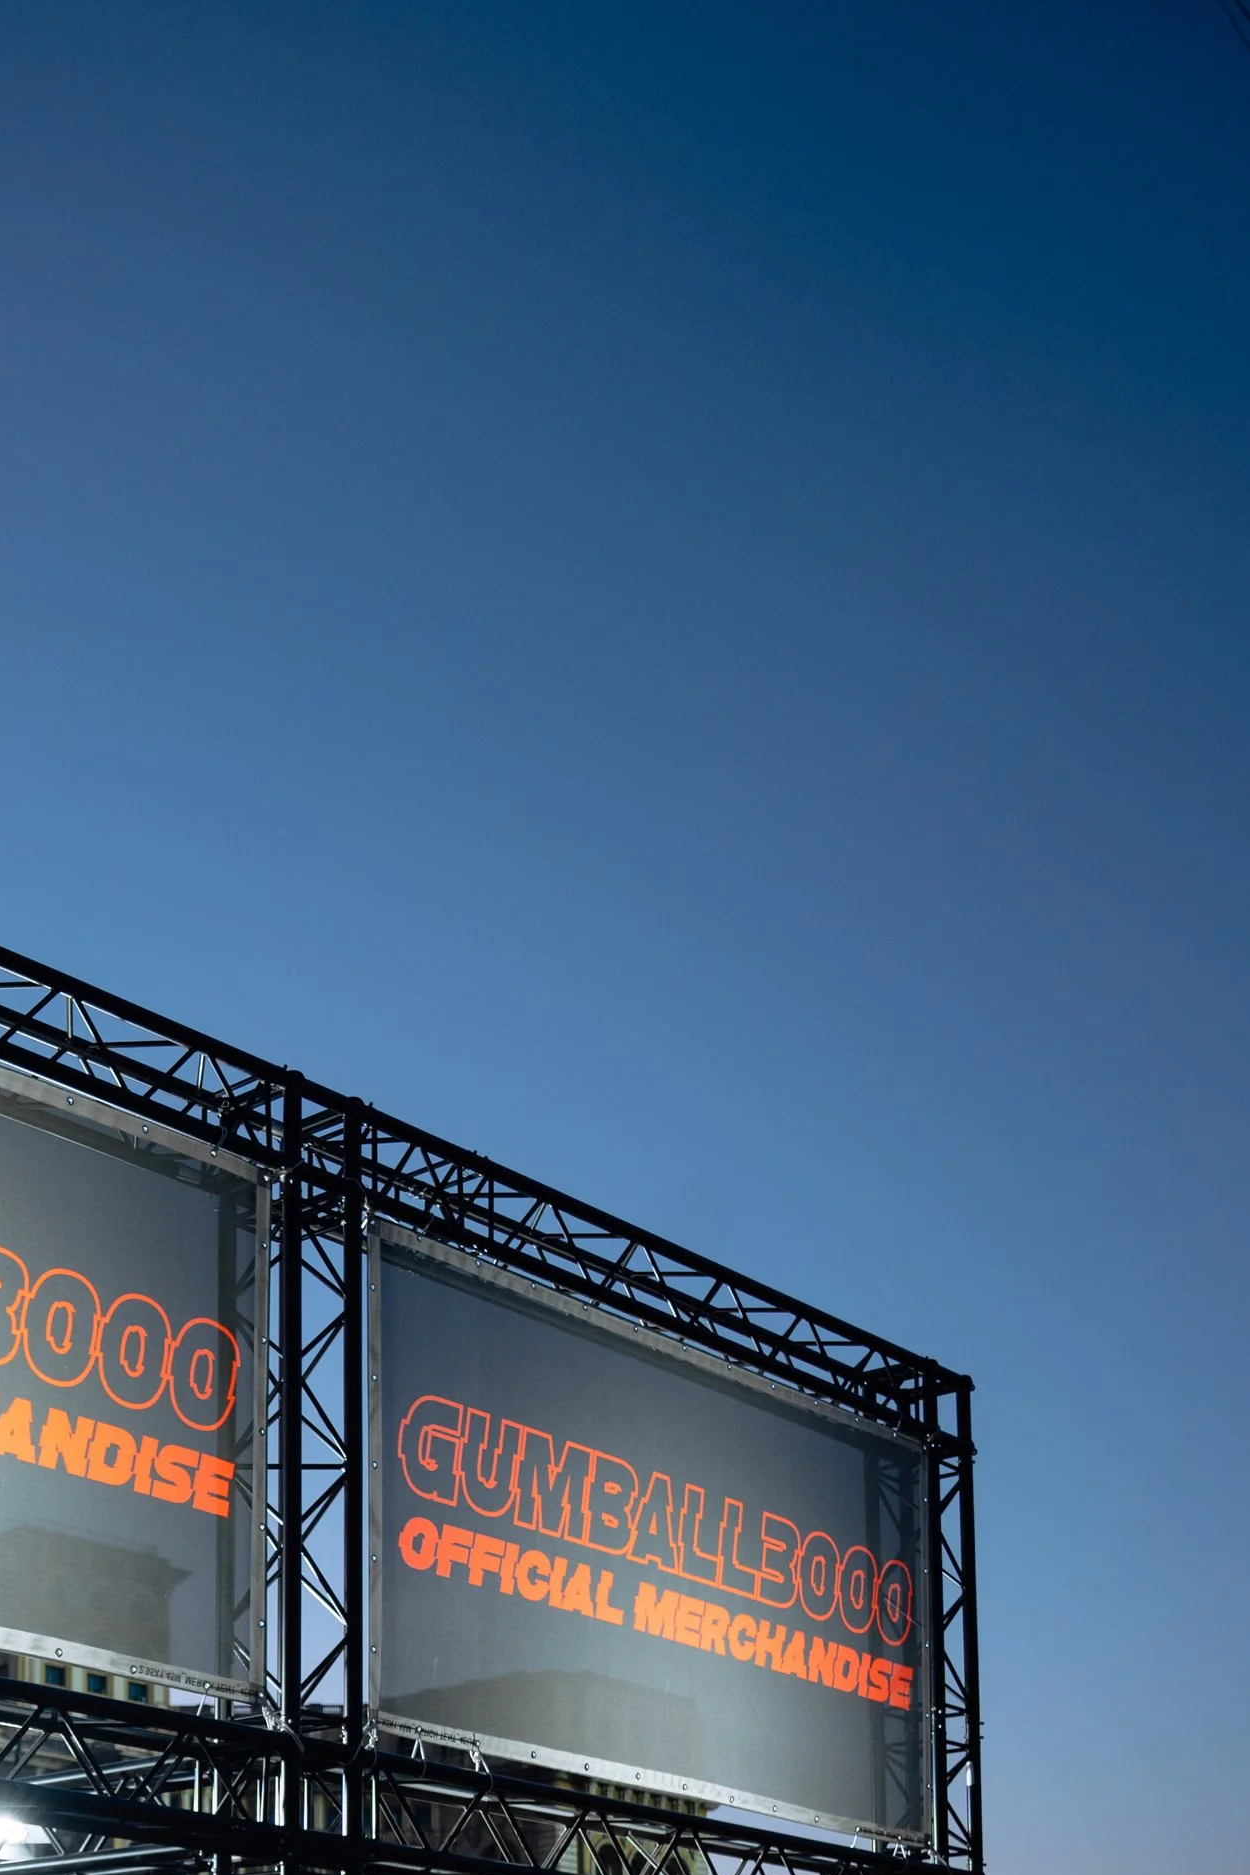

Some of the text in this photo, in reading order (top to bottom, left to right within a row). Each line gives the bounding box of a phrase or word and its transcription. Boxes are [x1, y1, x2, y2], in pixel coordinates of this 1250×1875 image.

[397, 1395, 914, 1647] GUMBALL3000
[398, 1516, 914, 1710] OFFICIAL MERCHANDISE
